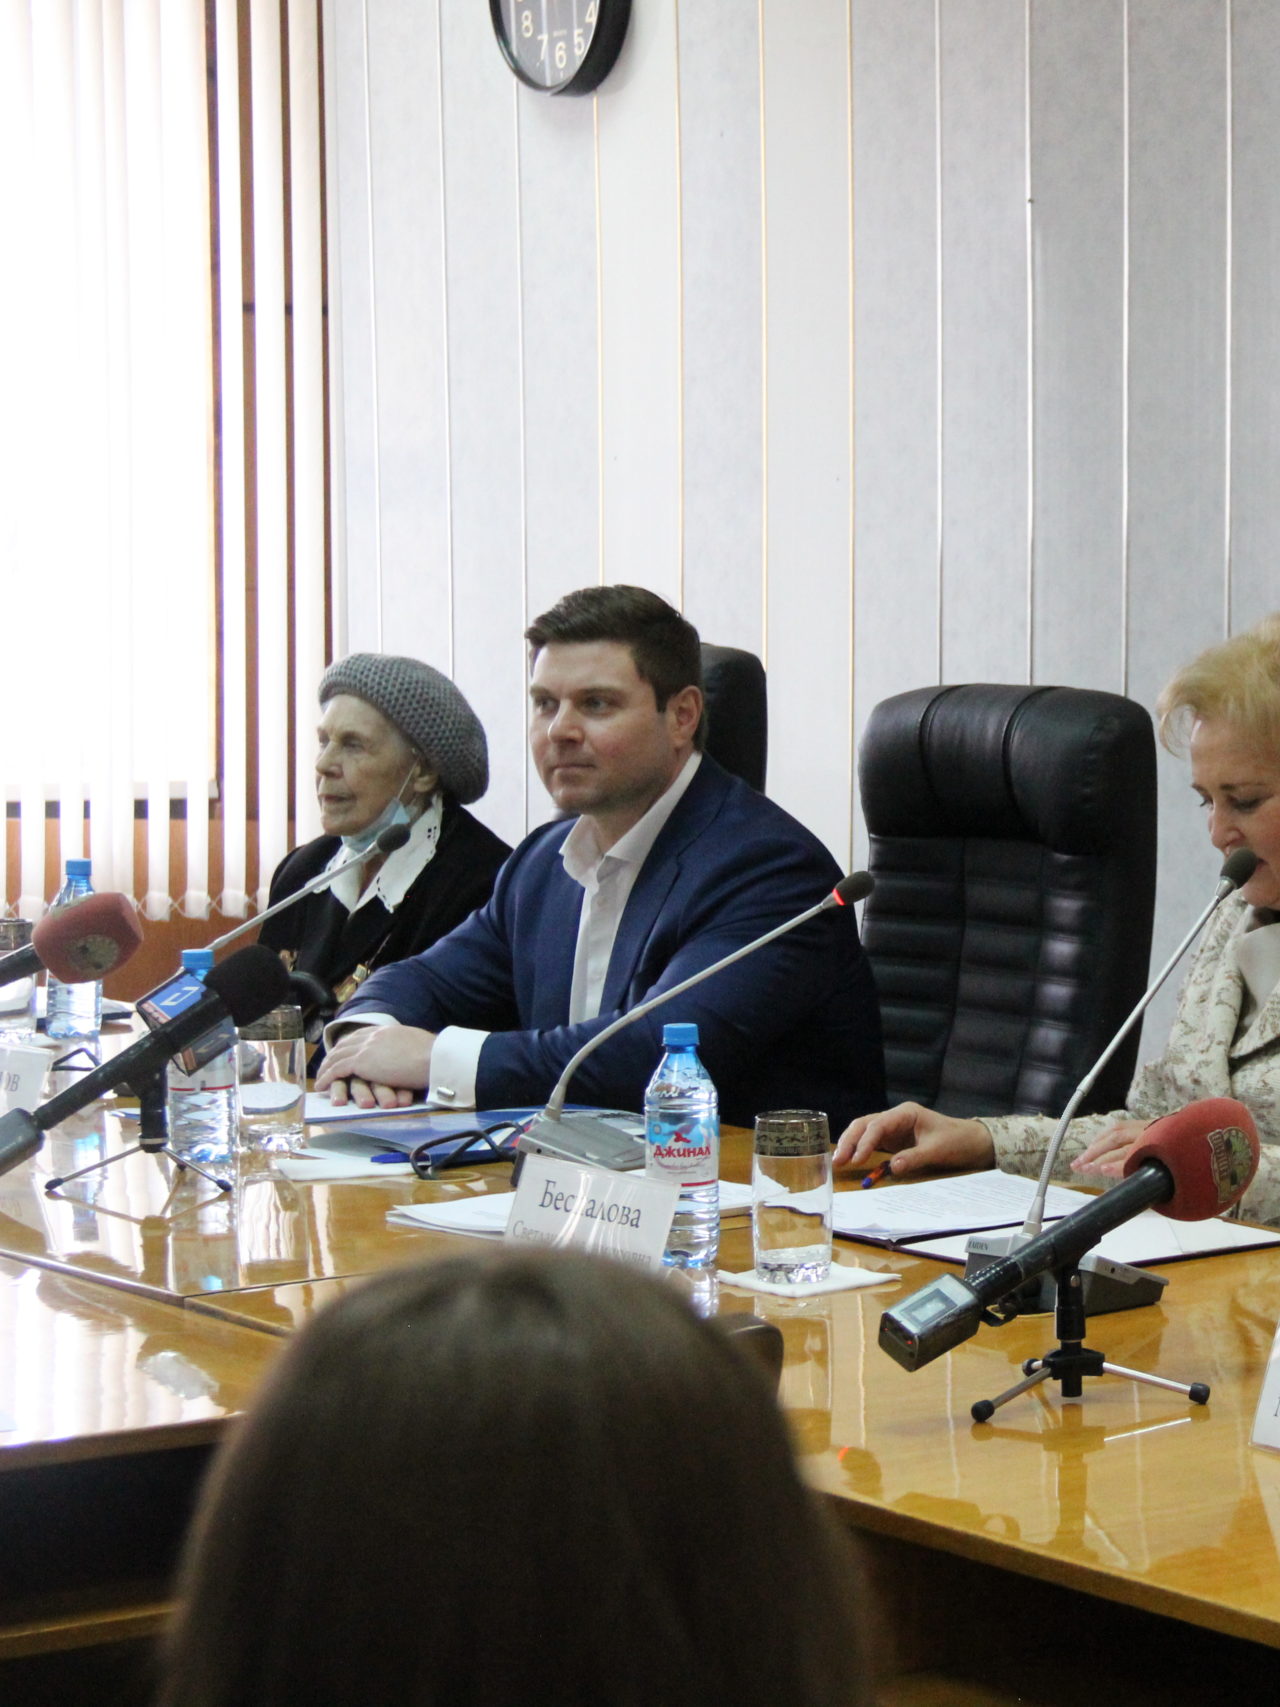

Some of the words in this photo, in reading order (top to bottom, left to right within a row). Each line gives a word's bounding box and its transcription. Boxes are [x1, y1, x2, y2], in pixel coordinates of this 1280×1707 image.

[521, 10, 534, 38] 8
[536, 34, 548, 61] 7
[555, 41, 567, 69] 6
[573, 28, 585, 56] 5
[538, 1179, 643, 1229] Бесалова
